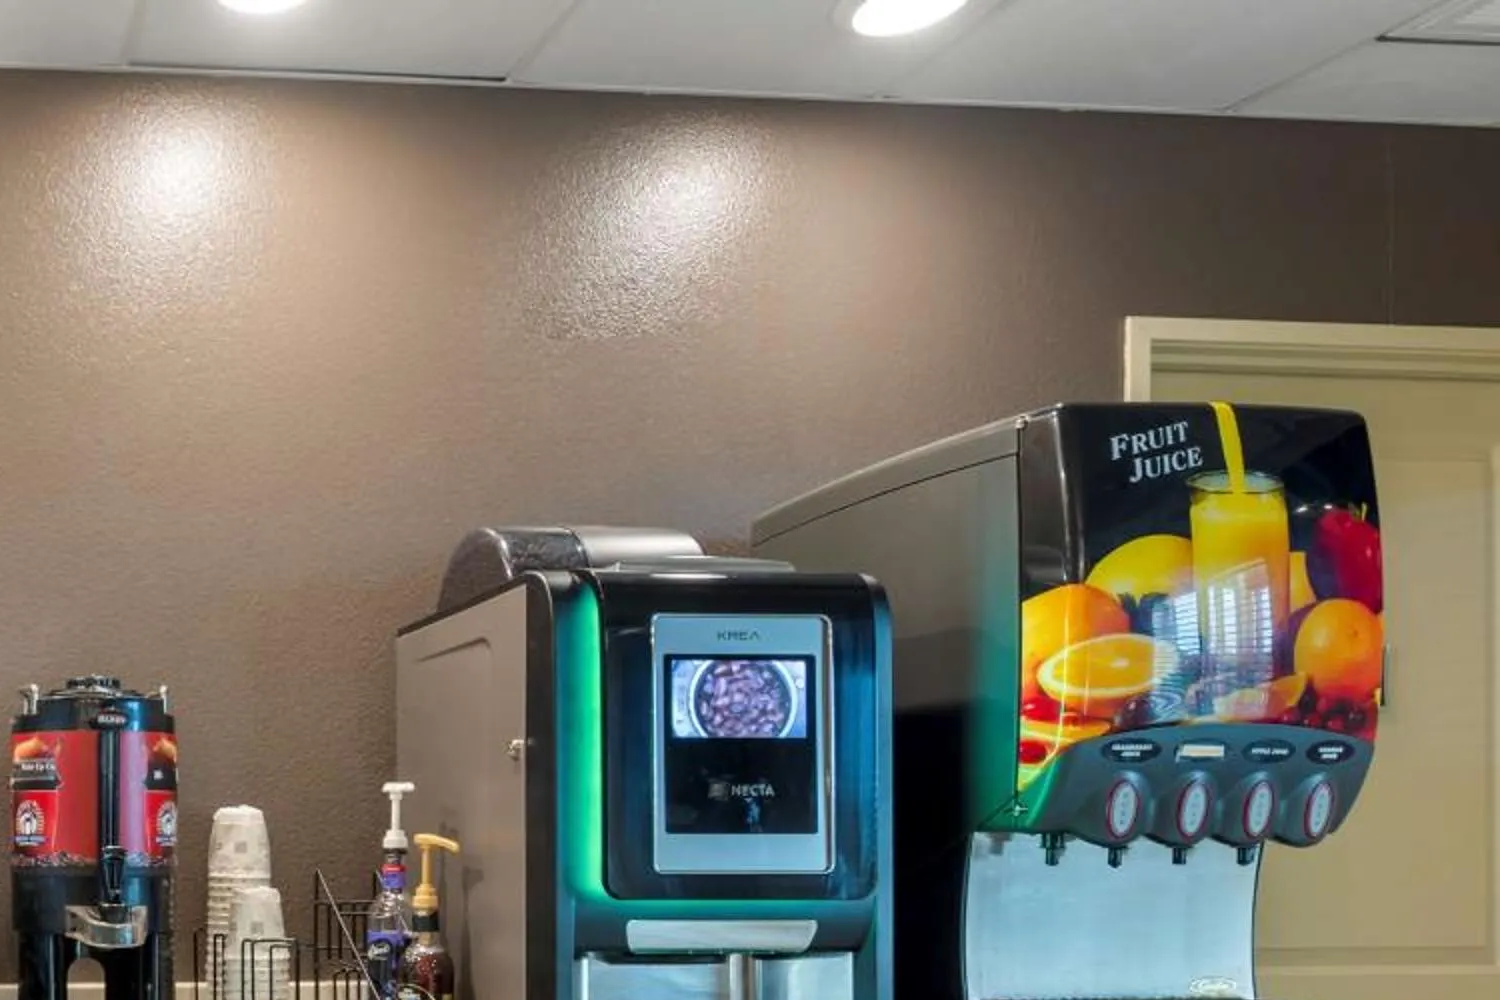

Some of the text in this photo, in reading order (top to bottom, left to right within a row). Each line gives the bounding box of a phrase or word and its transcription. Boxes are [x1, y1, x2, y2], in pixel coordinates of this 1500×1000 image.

[1109, 421, 1189, 461] FRUIT
[1129, 445, 1203, 483] JUICE
[731, 783, 776, 797] NECTA
